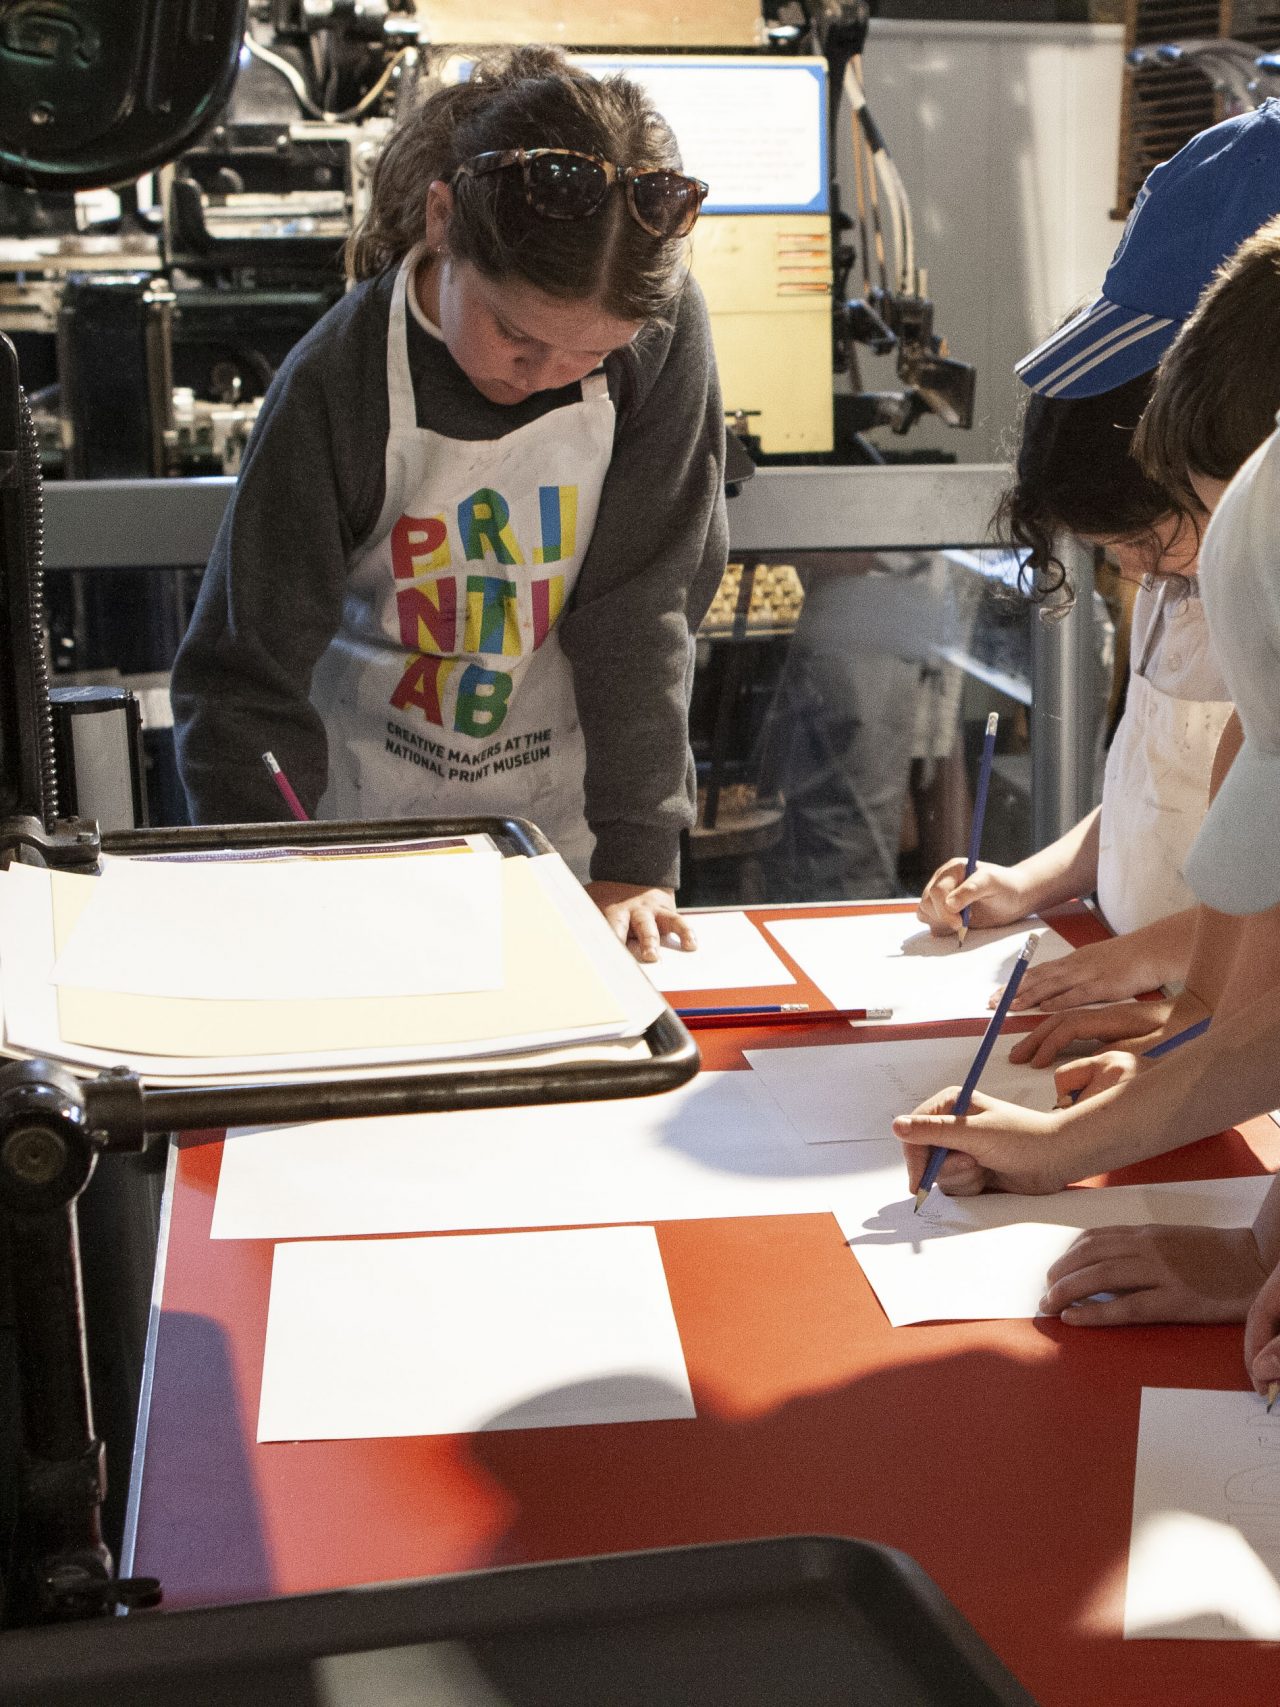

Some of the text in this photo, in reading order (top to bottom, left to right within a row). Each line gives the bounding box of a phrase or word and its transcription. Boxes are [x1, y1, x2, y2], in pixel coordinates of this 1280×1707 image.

[389, 655, 514, 738] AB
[385, 737, 552, 783] NATIONAL PRINT MUSEUM
[386, 721, 552, 766] CREATIVE MAKERS AT THE
